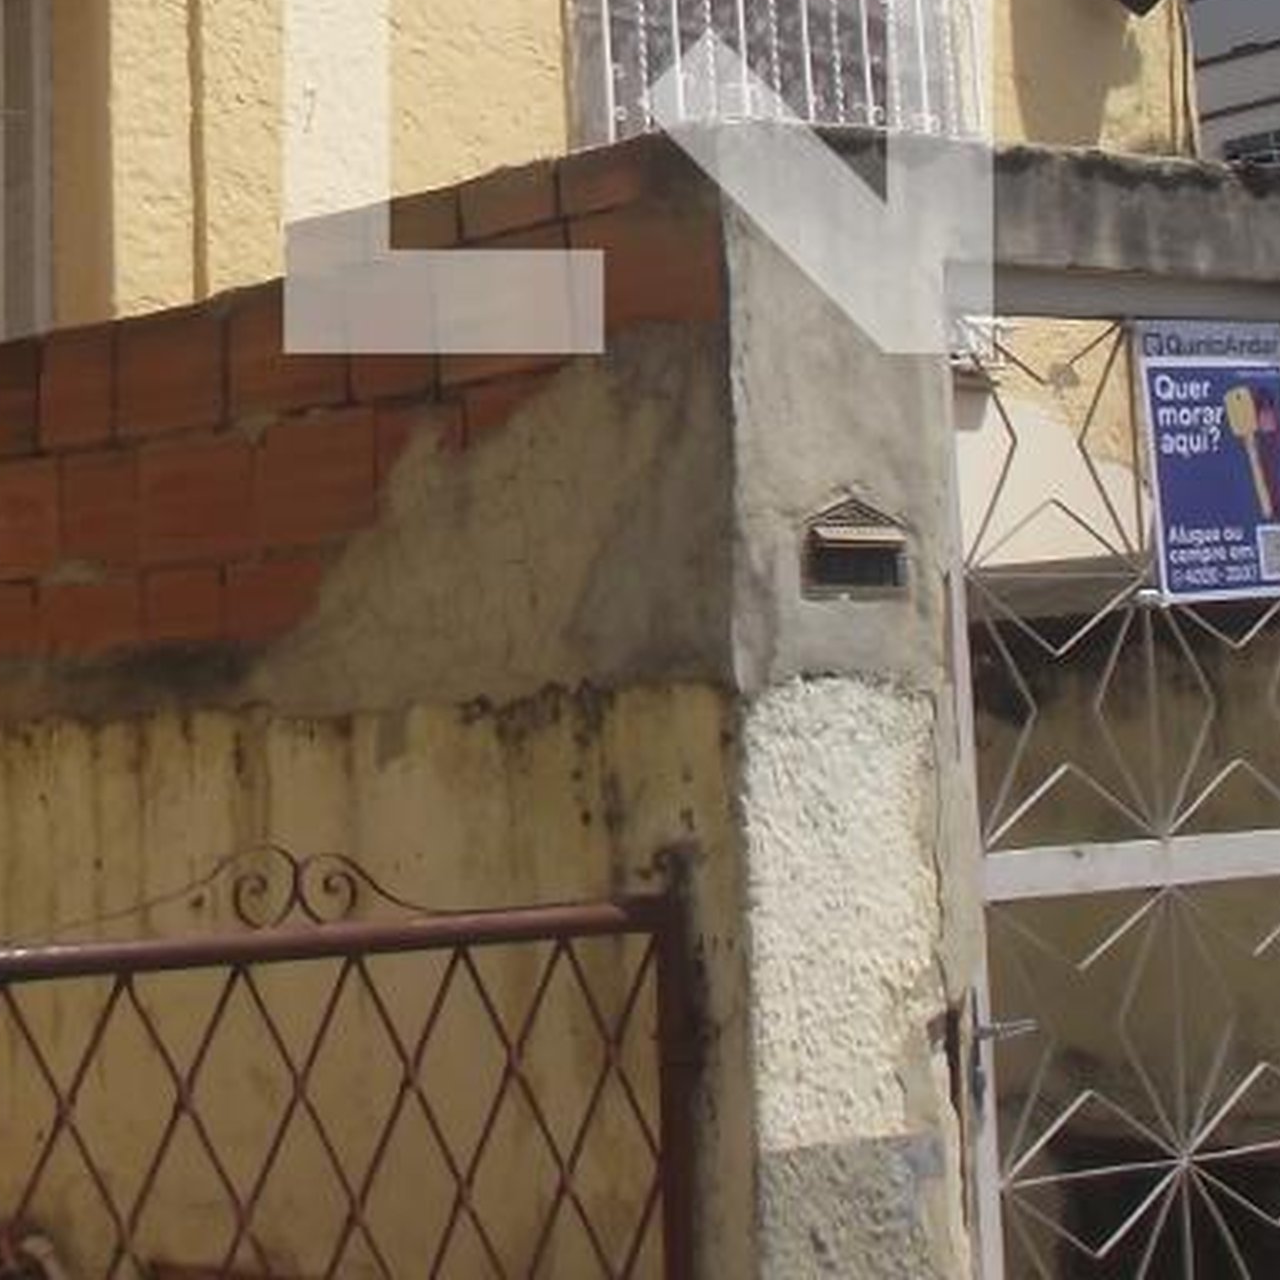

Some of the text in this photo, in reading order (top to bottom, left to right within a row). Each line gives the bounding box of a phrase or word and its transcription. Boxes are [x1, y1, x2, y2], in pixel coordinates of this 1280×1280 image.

[1155, 375, 1210, 400] Quer
[1158, 405, 1223, 426] morar
[1161, 427, 1221, 458] aqui?
[1223, 527, 1243, 541] ou
[1170, 545, 1255, 564] compre em
